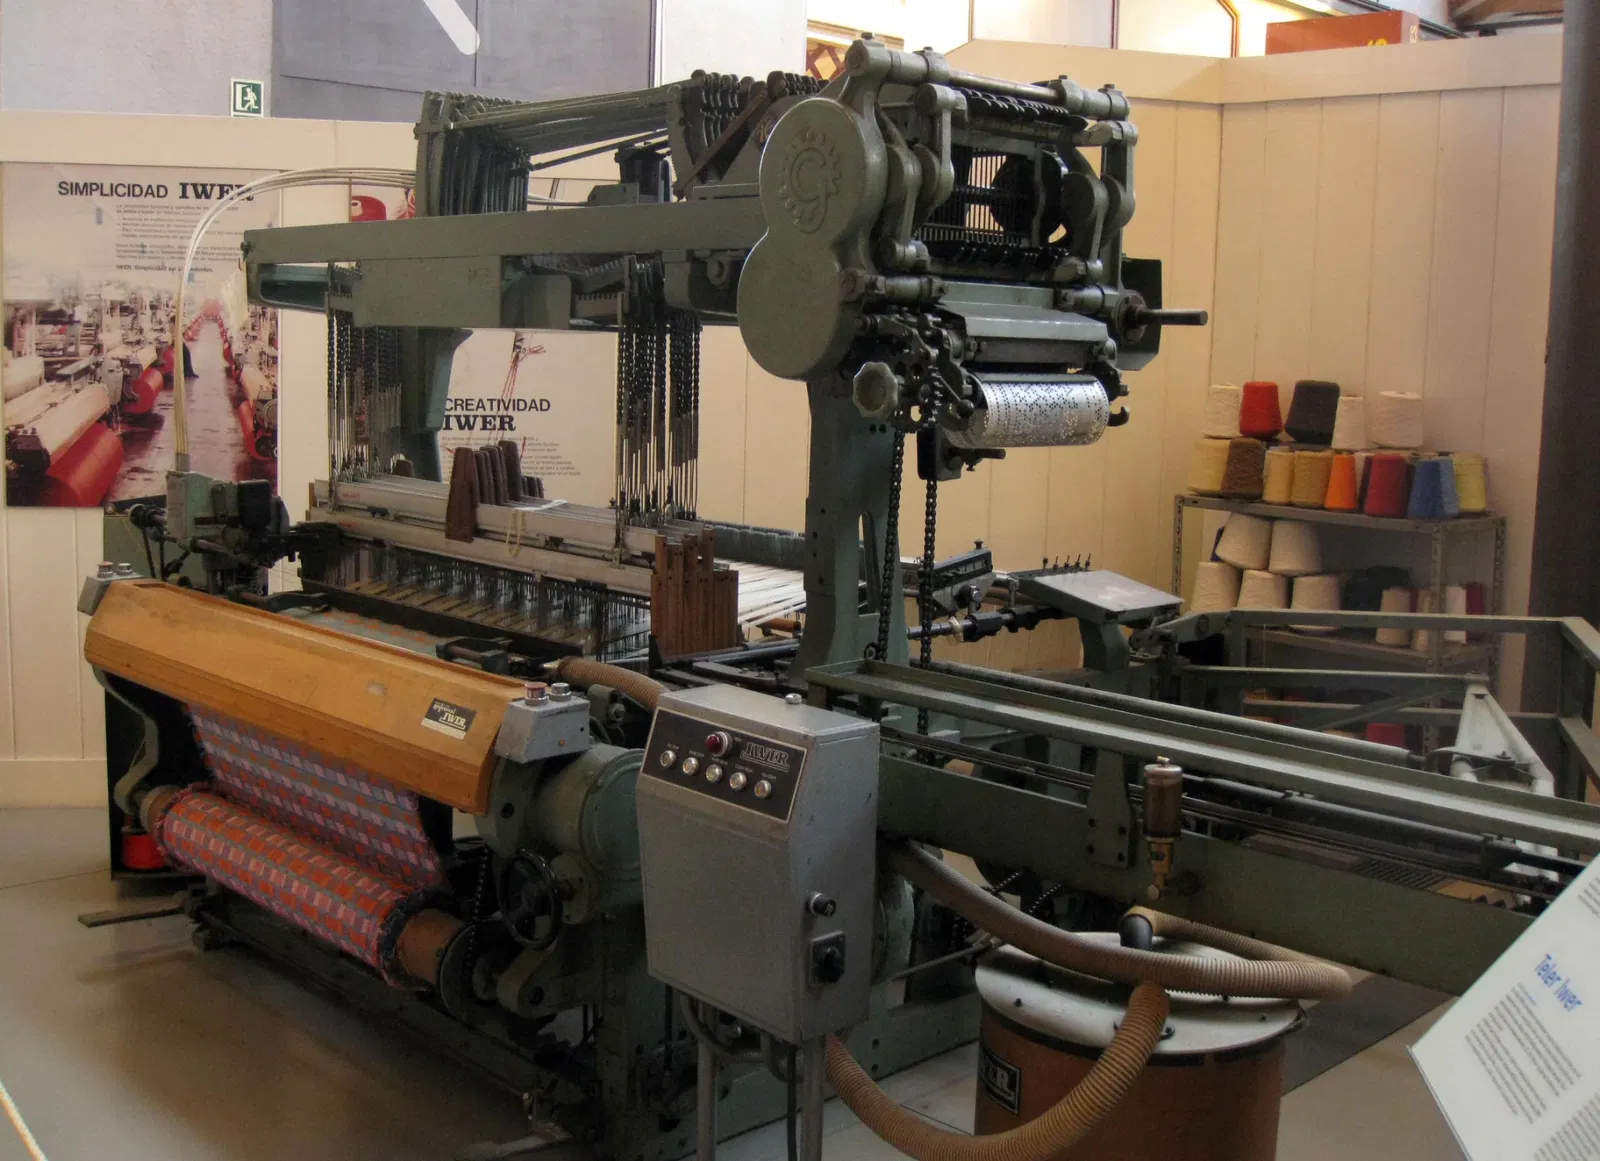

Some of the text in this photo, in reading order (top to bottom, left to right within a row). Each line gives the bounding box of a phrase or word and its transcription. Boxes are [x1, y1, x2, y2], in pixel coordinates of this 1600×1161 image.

[58, 181, 168, 199] SIMPLICIDAD
[445, 398, 551, 412] CREATIVIDAD
[443, 414, 516, 431] IWER
[442, 712, 467, 727] IWER
[745, 741, 789, 766] IWER
